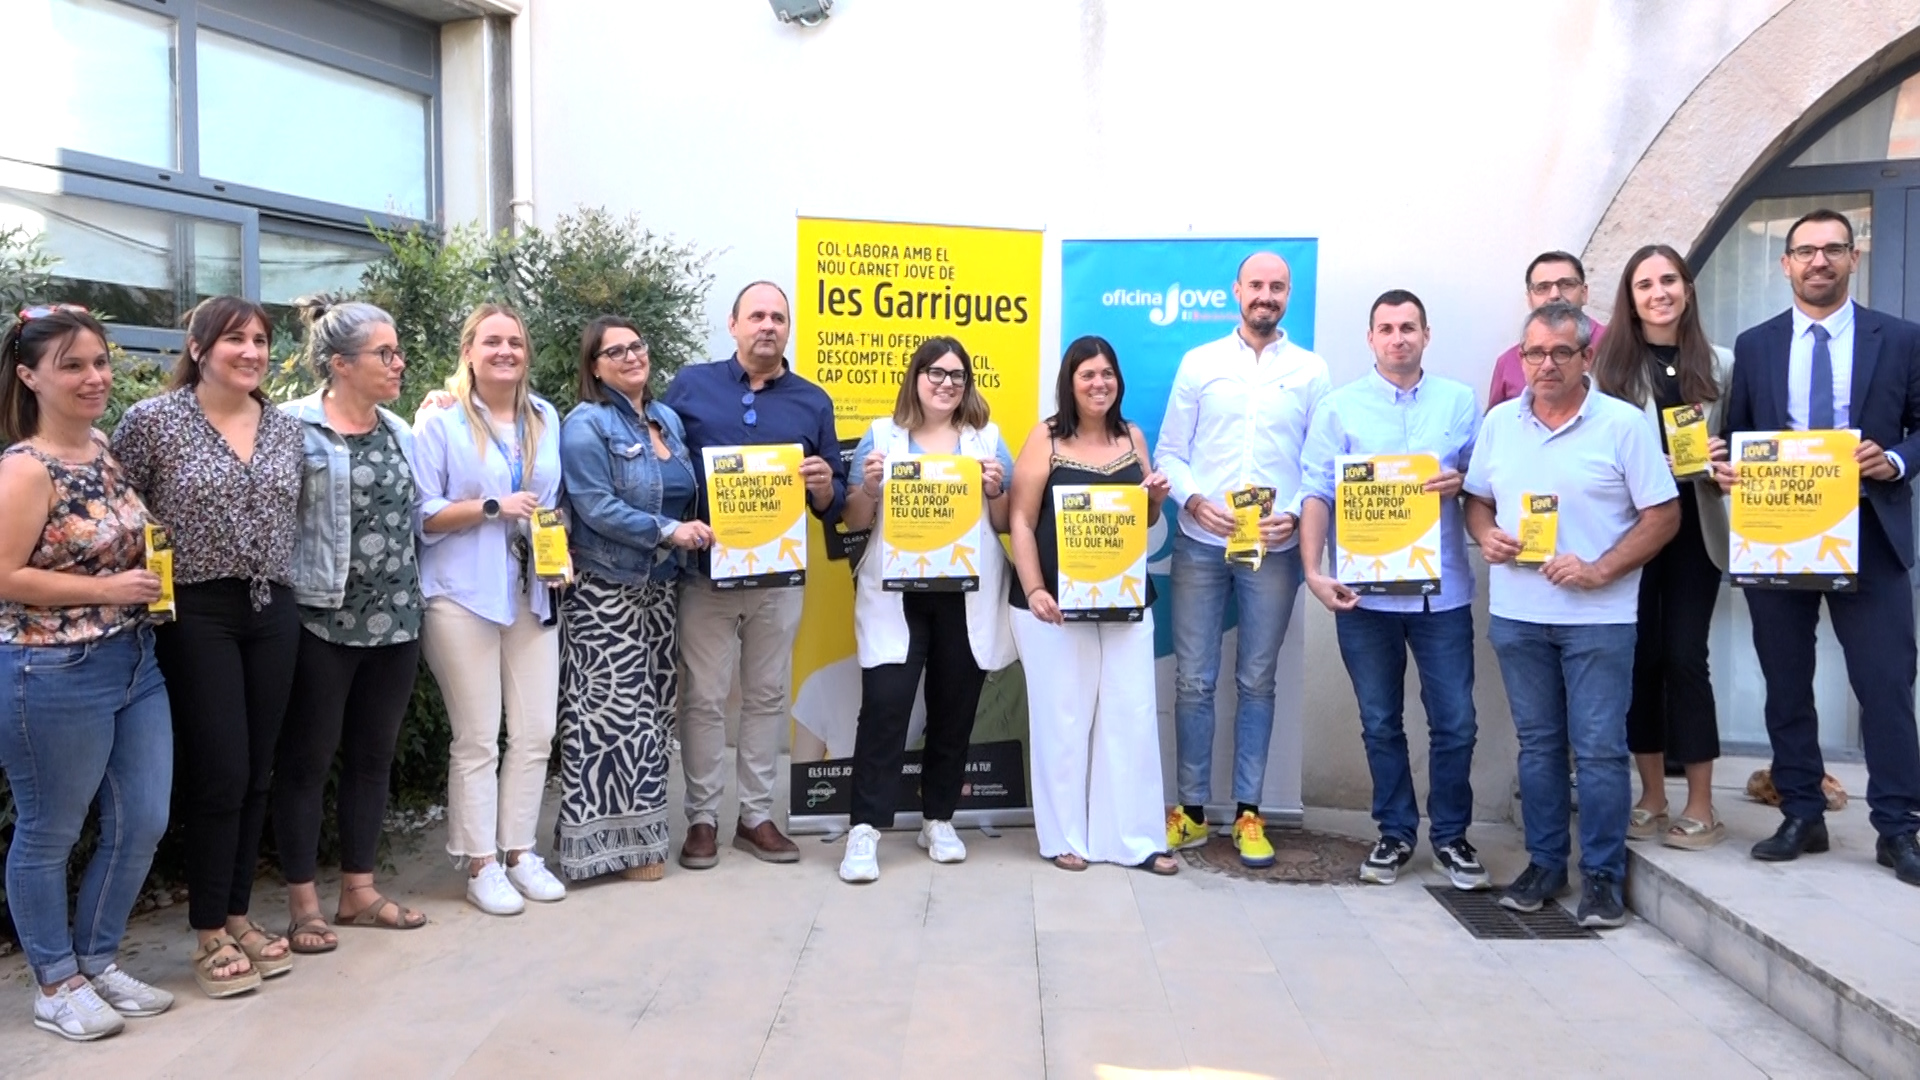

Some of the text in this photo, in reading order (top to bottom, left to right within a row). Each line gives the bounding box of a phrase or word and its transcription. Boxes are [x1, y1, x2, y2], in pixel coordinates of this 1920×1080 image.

[903, 246, 932, 261] AMB
[936, 247, 950, 262] EL
[817, 259, 955, 281] NOU CARNET JOVE DE
[818, 279, 1028, 326] les Garrigues
[1102, 289, 1162, 306] oficina
[817, 350, 898, 367] DESCOMPTE:
[817, 368, 843, 384] CAP
[847, 369, 877, 384] COST
[882, 371, 886, 384] I
[1740, 465, 1841, 478] EL CARNET JOVE
[714, 475, 793, 488] EL CARNET JOVE
[1768, 479, 1776, 491] A
[1780, 479, 1815, 491] PROP
[739, 489, 746, 499] A
[749, 488, 775, 499] PROP
[891, 483, 968, 496] EL CARNET JOVE
[1343, 484, 1425, 496] EL CARNET JOVE
[913, 495, 920, 506] A
[922, 495, 950, 506] PROP
[1367, 497, 1374, 508] A
[1376, 497, 1405, 508] PROP
[1740, 493, 1822, 506] TEU QUE MAI!
[718, 500, 781, 513] TEU QUE MAI!
[891, 507, 955, 519] TEU QUE MAI!
[1063, 514, 1136, 526] EL CARNET JOVE
[1344, 508, 1411, 521] TEU QUE MAI!
[1085, 526, 1092, 535] A
[1094, 525, 1119, 536] PROP
[1065, 537, 1124, 549] TEU QUE MAI!
[808, 767, 822, 778] ELS
[827, 766, 841, 777] LES
